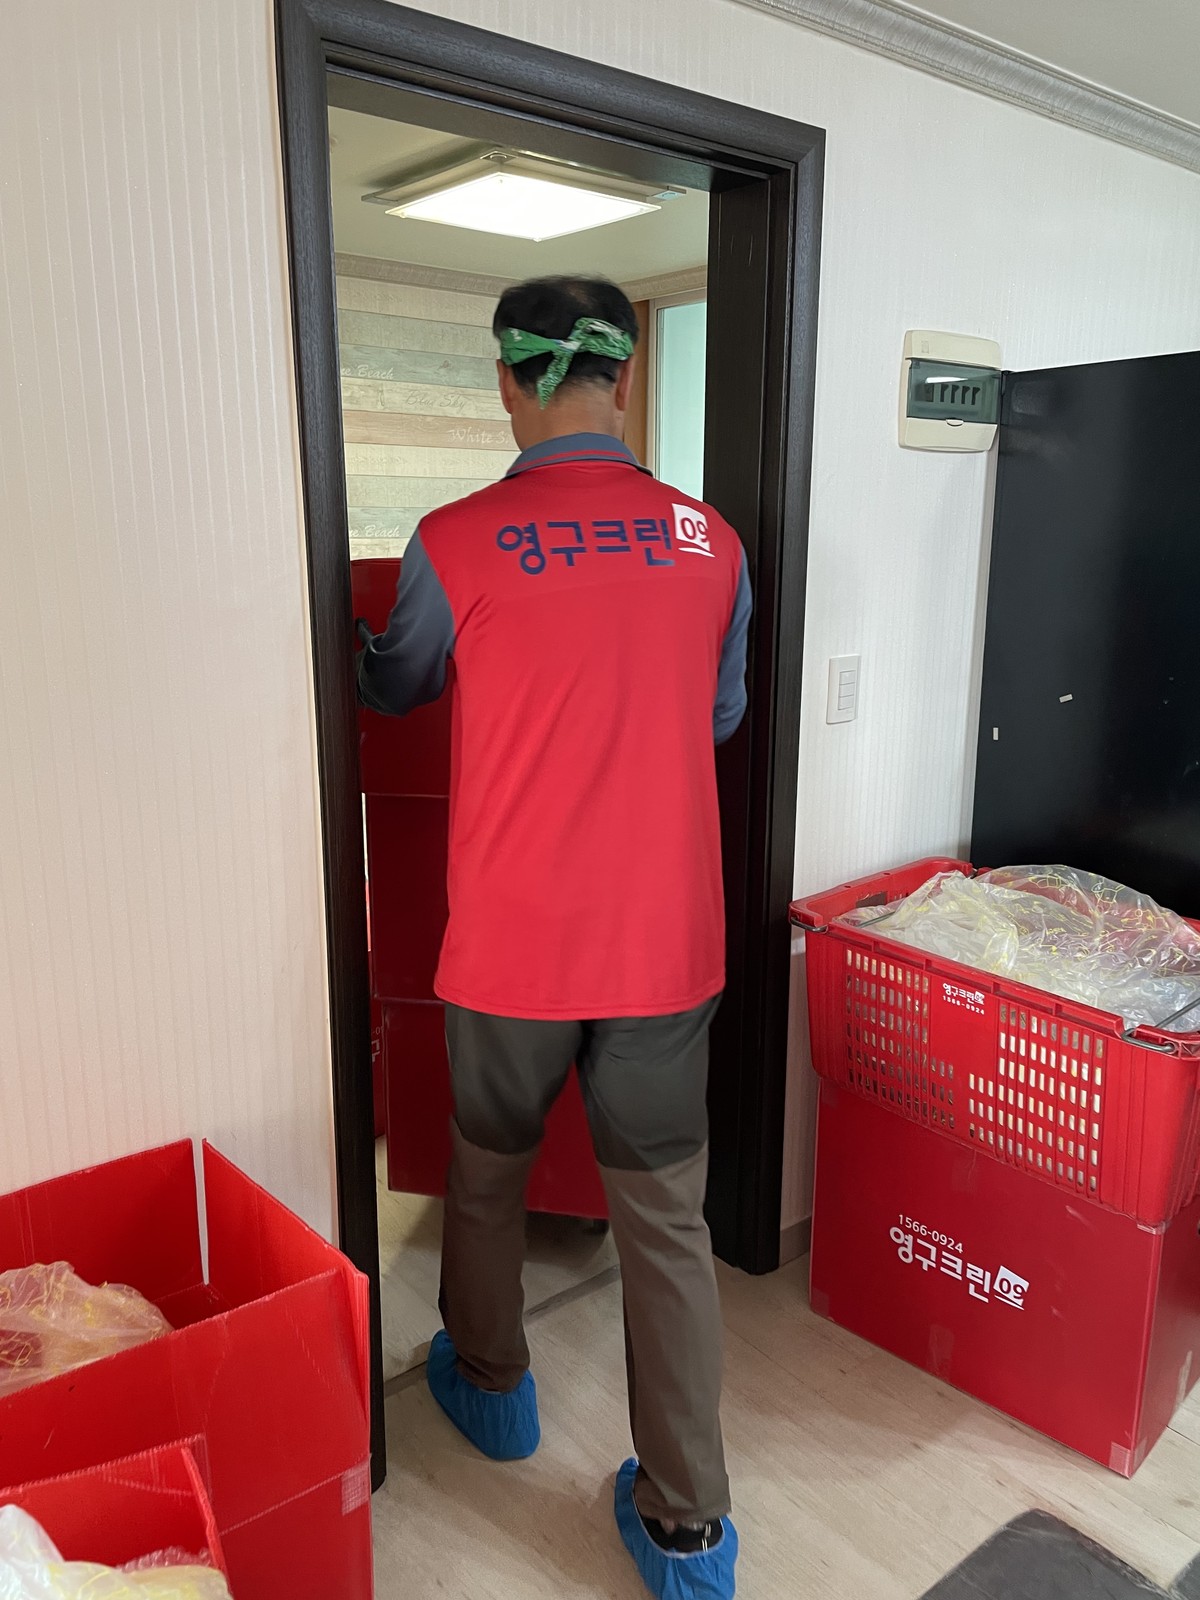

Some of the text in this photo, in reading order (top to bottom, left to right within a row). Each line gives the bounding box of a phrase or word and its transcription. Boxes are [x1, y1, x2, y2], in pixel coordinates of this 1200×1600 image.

[358, 364, 394, 380] Beach
[440, 393, 466, 412] Sky
[447, 426, 494, 444] White
[364, 524, 400, 538] Beach
[496, 518, 676, 576] 영구크린
[942, 982, 974, 1005] 영구크린
[898, 1214, 964, 1254] 1566-0924
[889, 1226, 992, 1304] 영구크린
